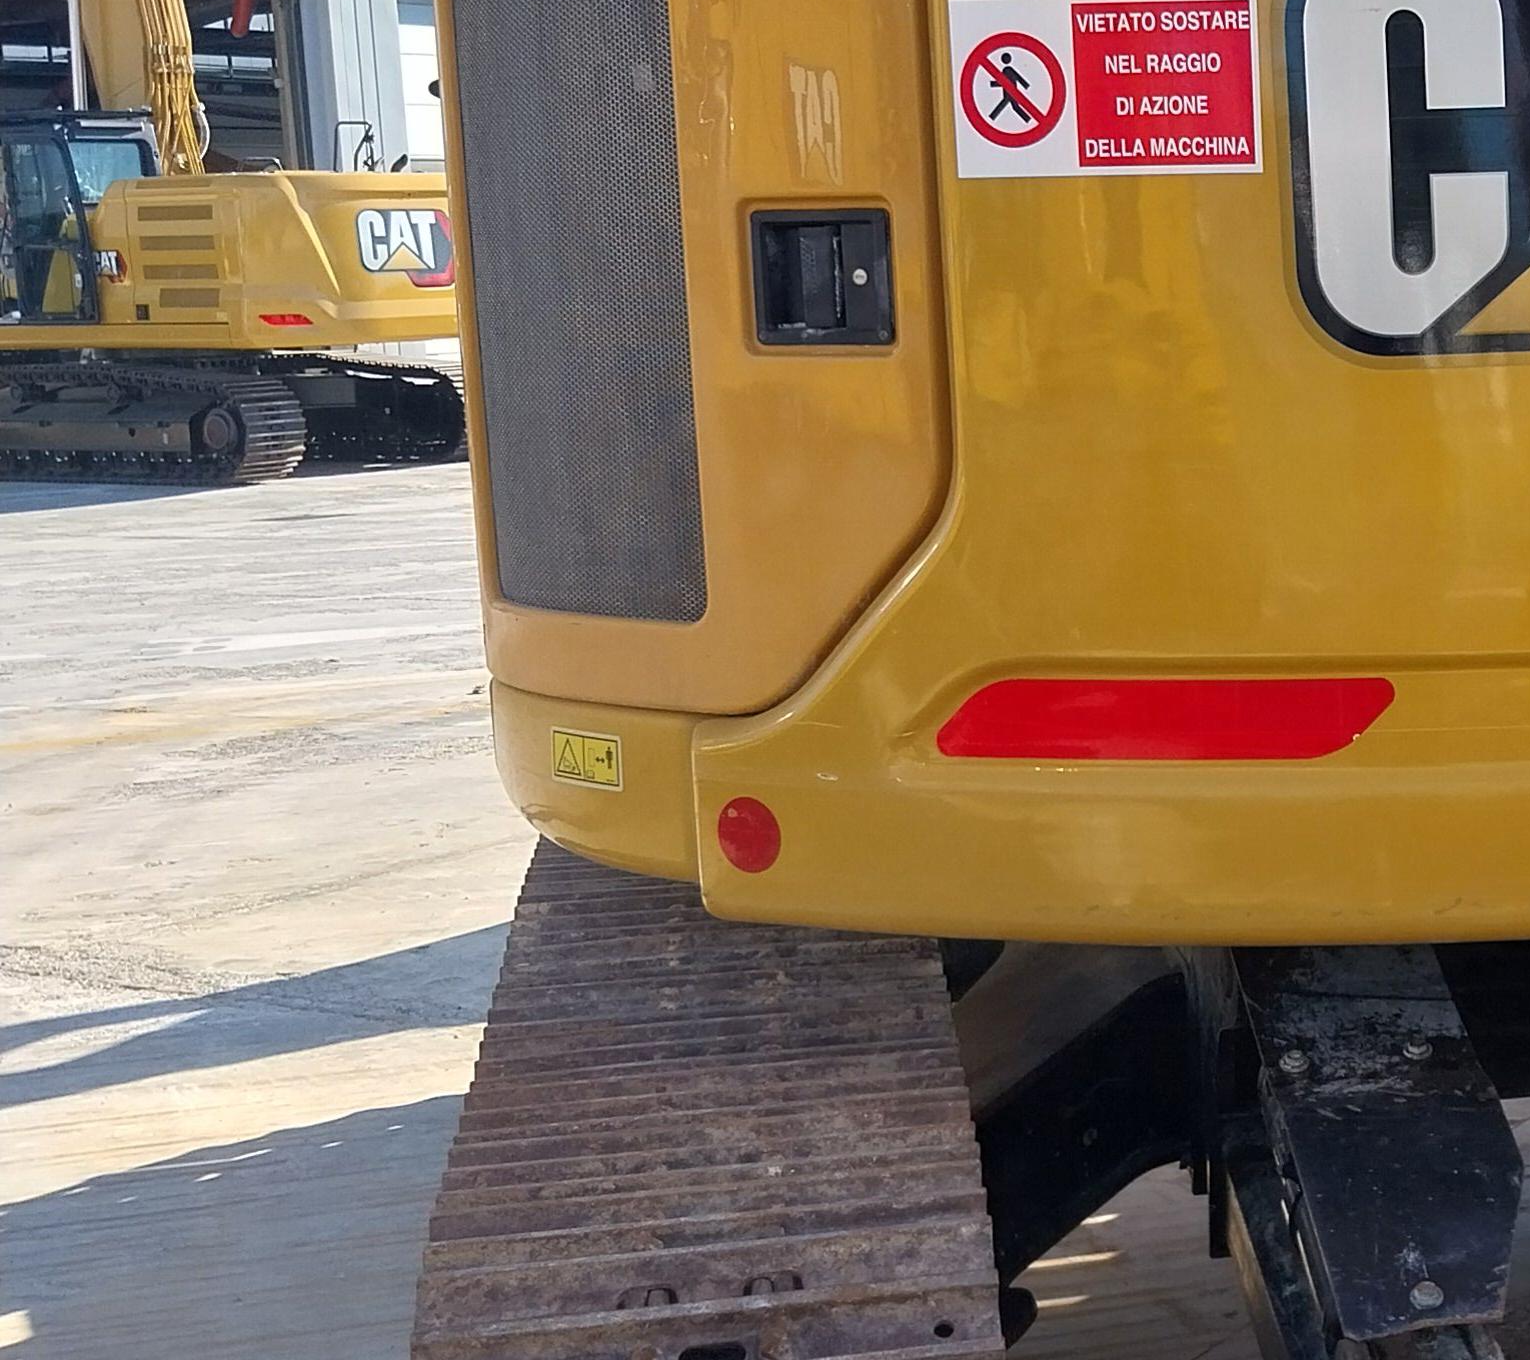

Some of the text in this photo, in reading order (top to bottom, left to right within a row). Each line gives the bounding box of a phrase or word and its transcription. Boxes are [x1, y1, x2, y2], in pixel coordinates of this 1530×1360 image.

[1076, 10, 1250, 33] VIETATO SOSTARE
[1104, 52, 1221, 74] NEL RAGGIO
[1116, 95, 1209, 116] DI AZIONE
[1085, 136, 1251, 158] DELLA MACCHINA
[357, 209, 437, 271] CAT
